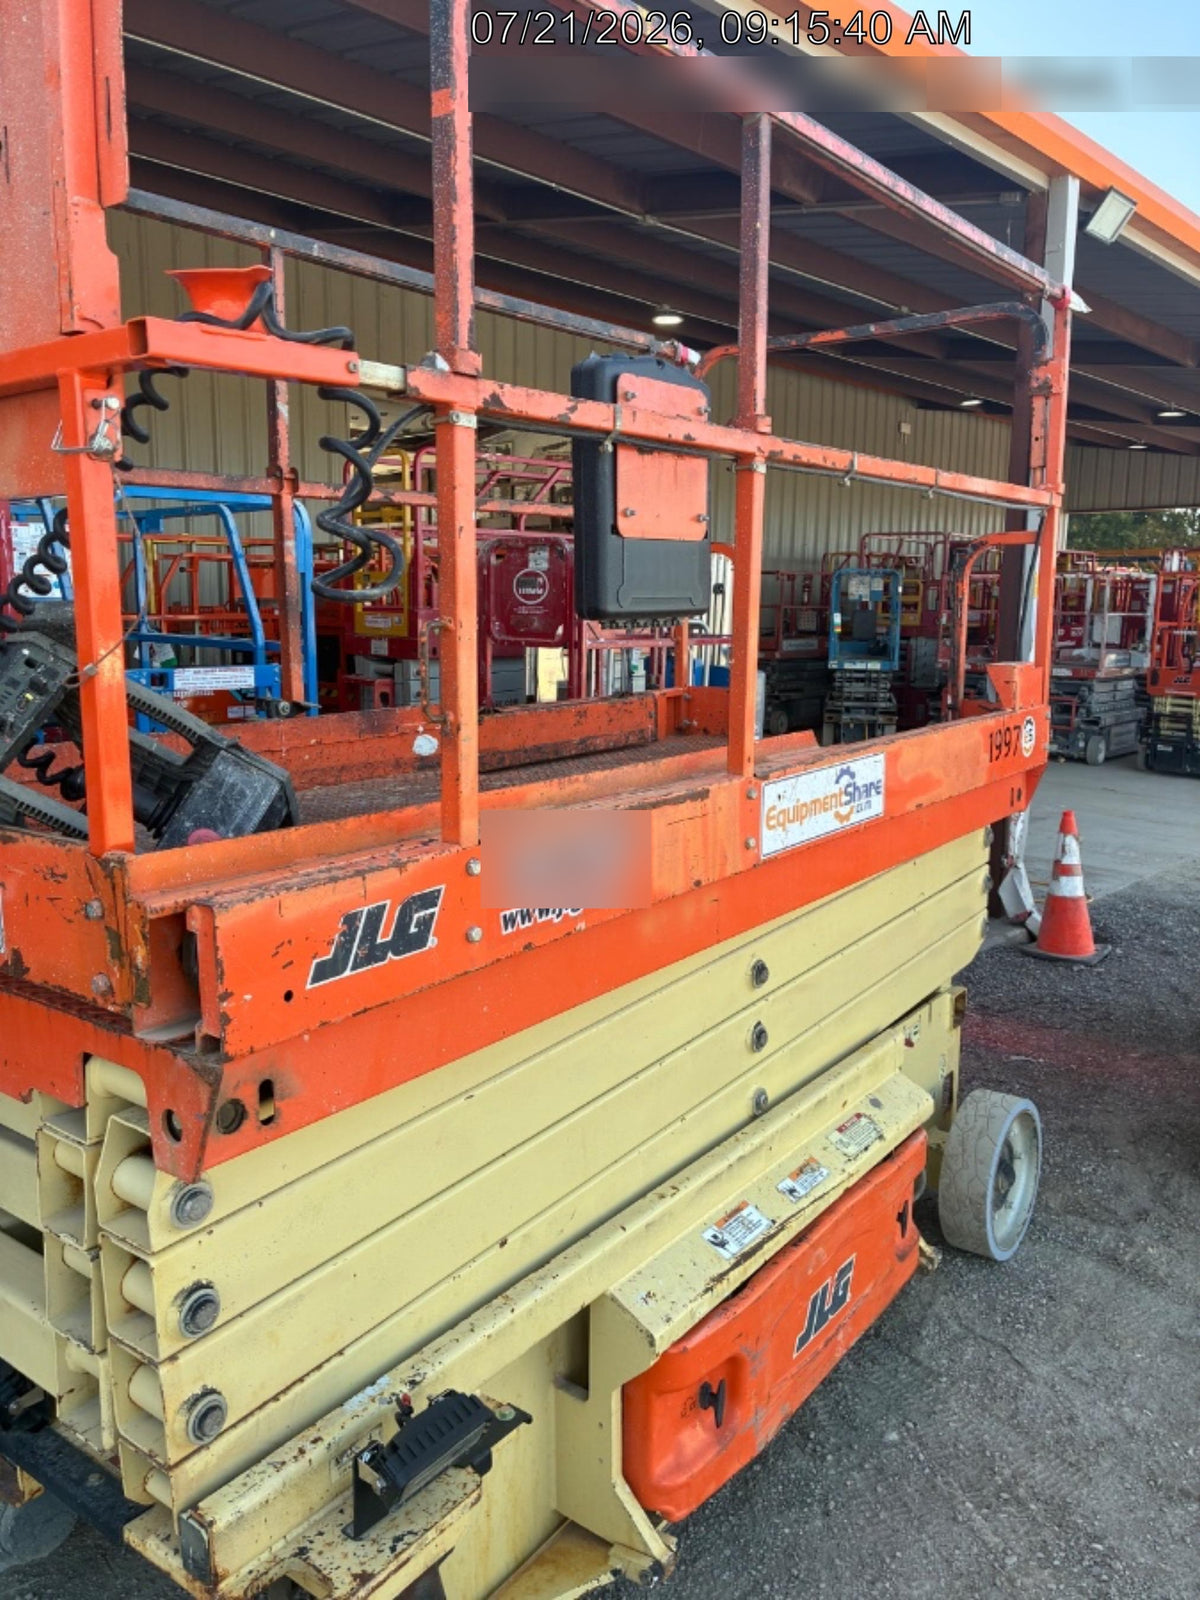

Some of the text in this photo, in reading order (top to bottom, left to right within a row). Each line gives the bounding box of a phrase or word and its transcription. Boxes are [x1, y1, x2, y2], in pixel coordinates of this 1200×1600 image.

[989, 724, 1021, 763] 1997
[766, 779, 882, 832] EquipmentShare
[306, 884, 446, 990] JLG
[793, 1252, 857, 1360] JLG
